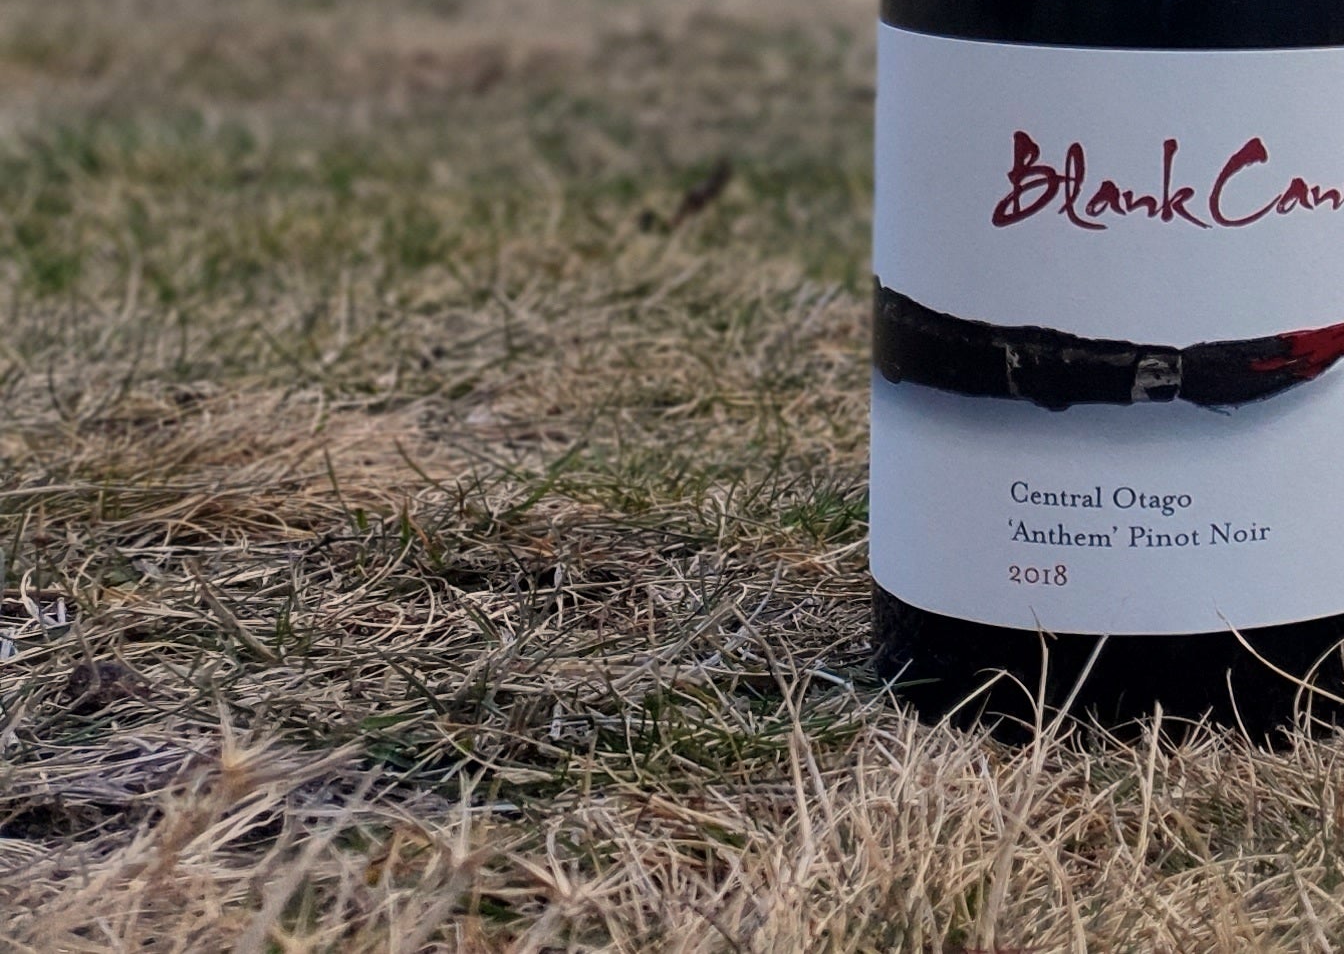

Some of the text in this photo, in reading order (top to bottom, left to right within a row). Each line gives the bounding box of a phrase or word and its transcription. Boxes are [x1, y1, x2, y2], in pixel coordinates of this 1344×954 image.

[991, 130, 1213, 230] Blank
[1010, 481, 1193, 517] Central Otago
[1128, 524, 1201, 549] Pinot
[1208, 521, 1272, 546] Noir
[1008, 565, 1069, 588] 2018
